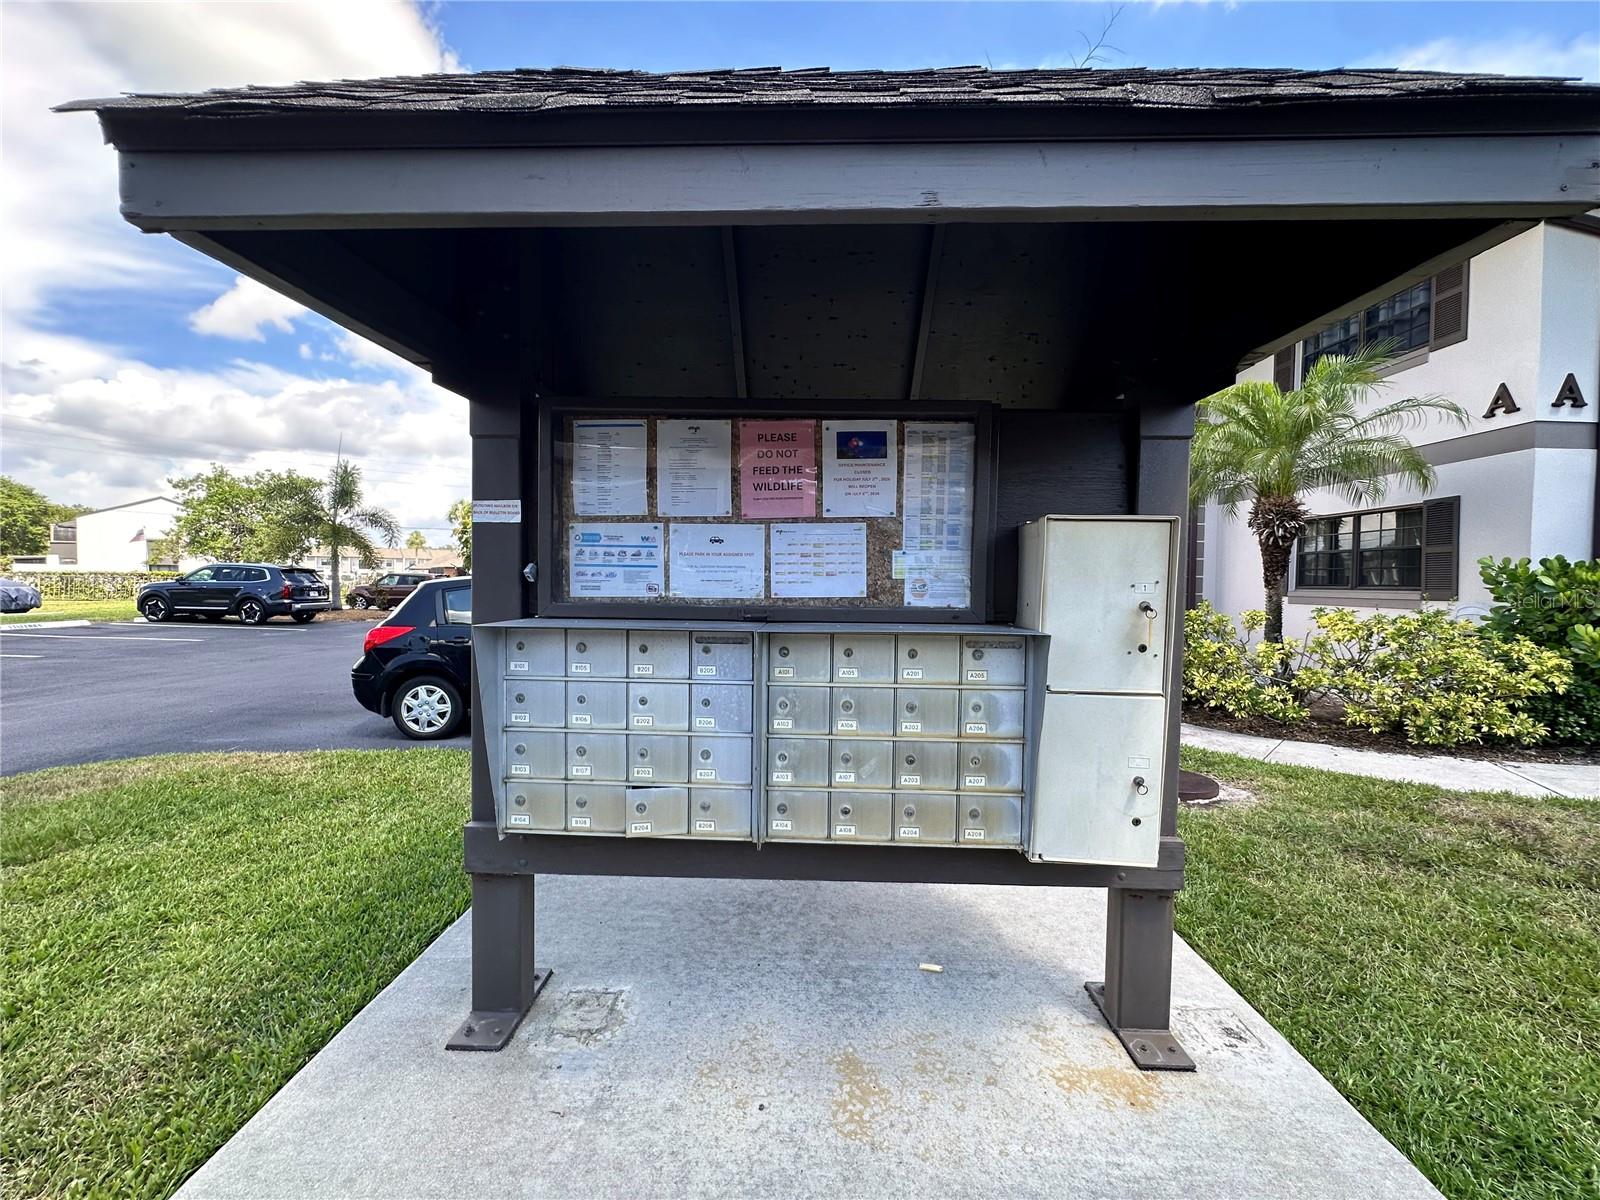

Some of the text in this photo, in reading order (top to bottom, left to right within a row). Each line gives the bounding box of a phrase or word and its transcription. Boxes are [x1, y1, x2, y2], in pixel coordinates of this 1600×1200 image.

[1551, 373, 1588, 408] A
[1482, 382, 1521, 419] A
[757, 432, 798, 442] PLEASE
[757, 449, 799, 459] DO NOT
[752, 465, 803, 475] FEED THE
[752, 481, 803, 491] WILDLIFE
[1143, 584, 1147, 592] 1
